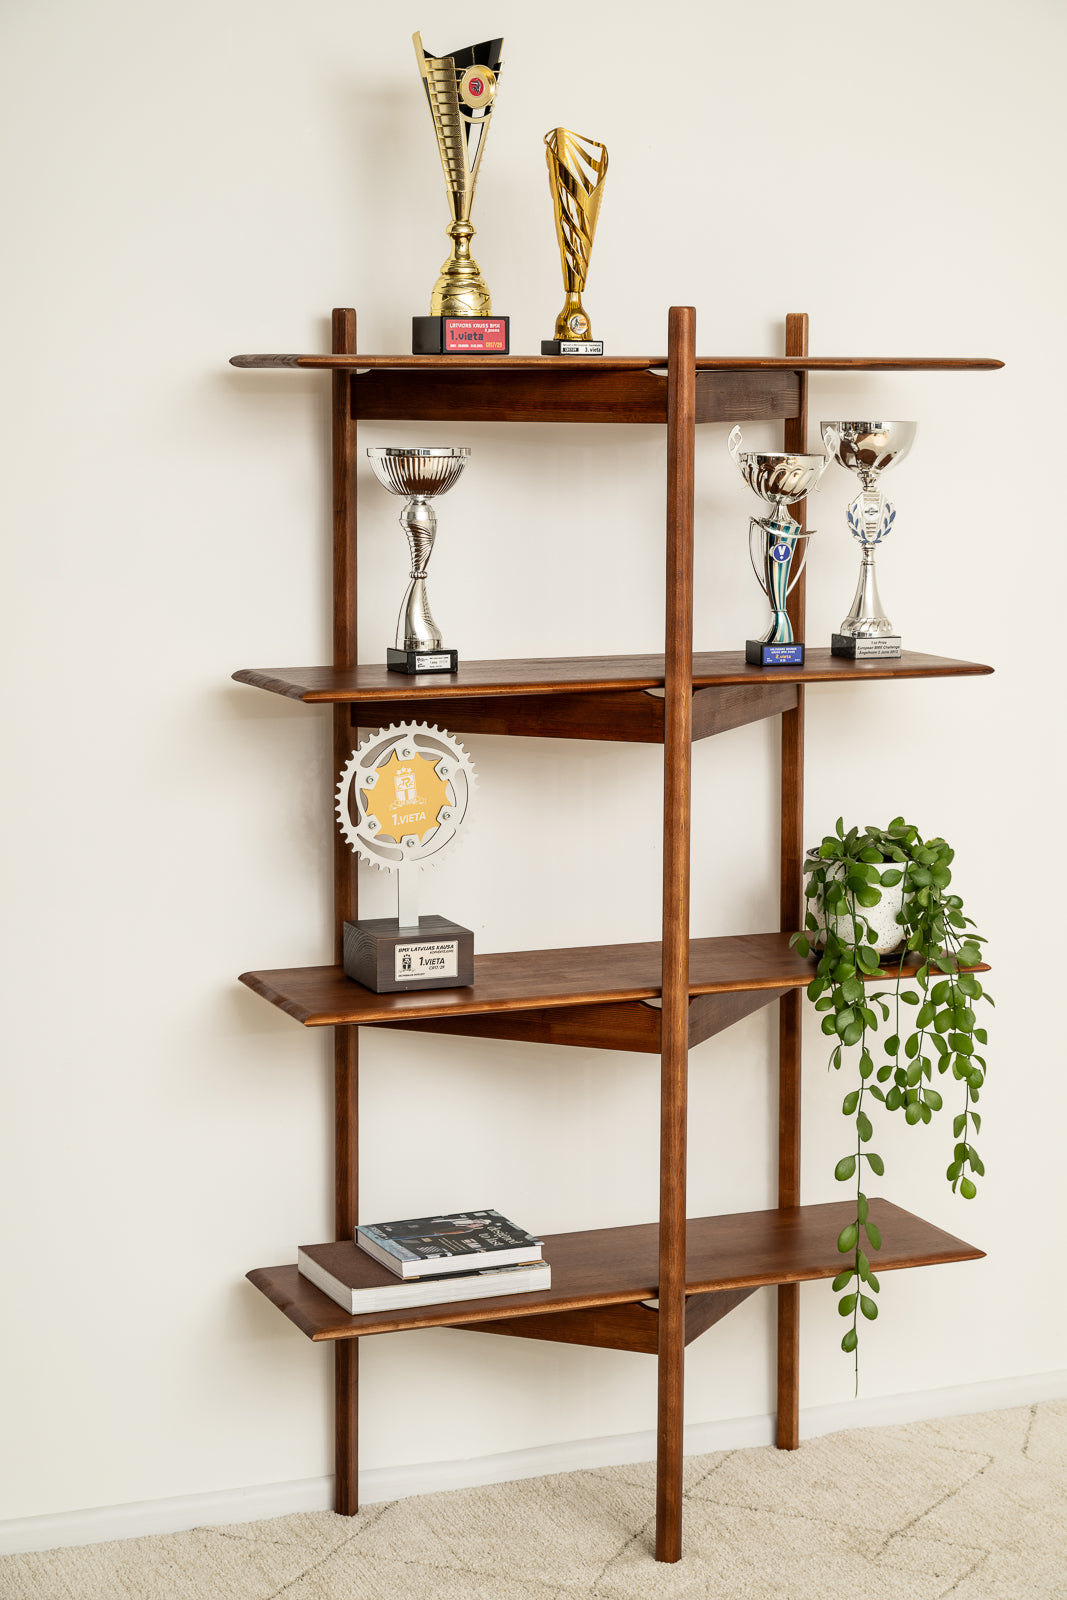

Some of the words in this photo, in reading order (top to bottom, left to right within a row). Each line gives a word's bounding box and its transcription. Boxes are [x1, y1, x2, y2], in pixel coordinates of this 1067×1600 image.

[450, 330, 484, 341] 1.vieta
[391, 811, 427, 826] 1.VIETA
[419, 956, 445, 966] 1.VIETA
